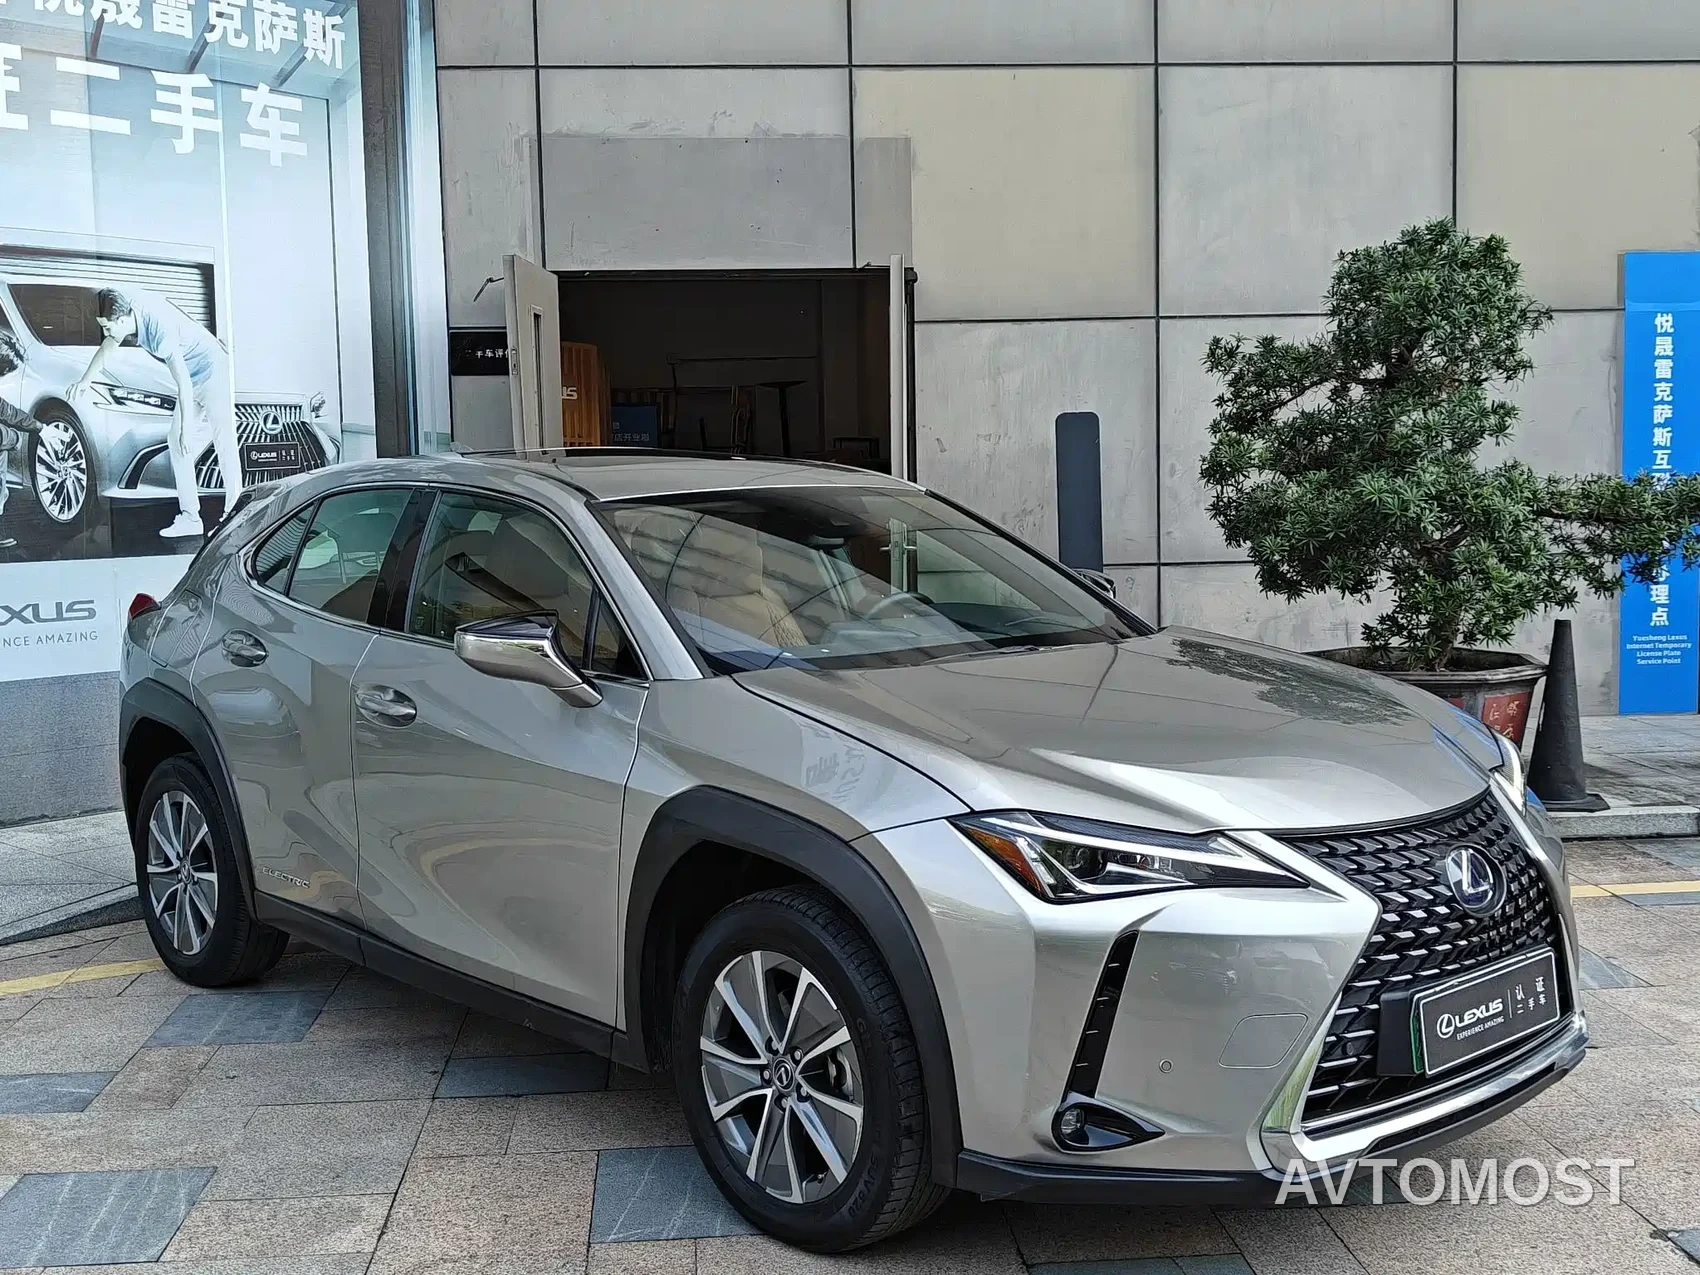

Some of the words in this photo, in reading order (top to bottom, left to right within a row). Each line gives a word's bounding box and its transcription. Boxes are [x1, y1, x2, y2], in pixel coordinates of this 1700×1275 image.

[36, 630, 98, 643] AMAZING
[1632, 634, 1666, 642] Yuesheng
[262, 867, 310, 888] ELECTRIC
[1455, 998, 1503, 1027] LEXUS
[1456, 1025, 1485, 1041] EXPERIENCE
[1485, 1015, 1504, 1030] AMAZING
